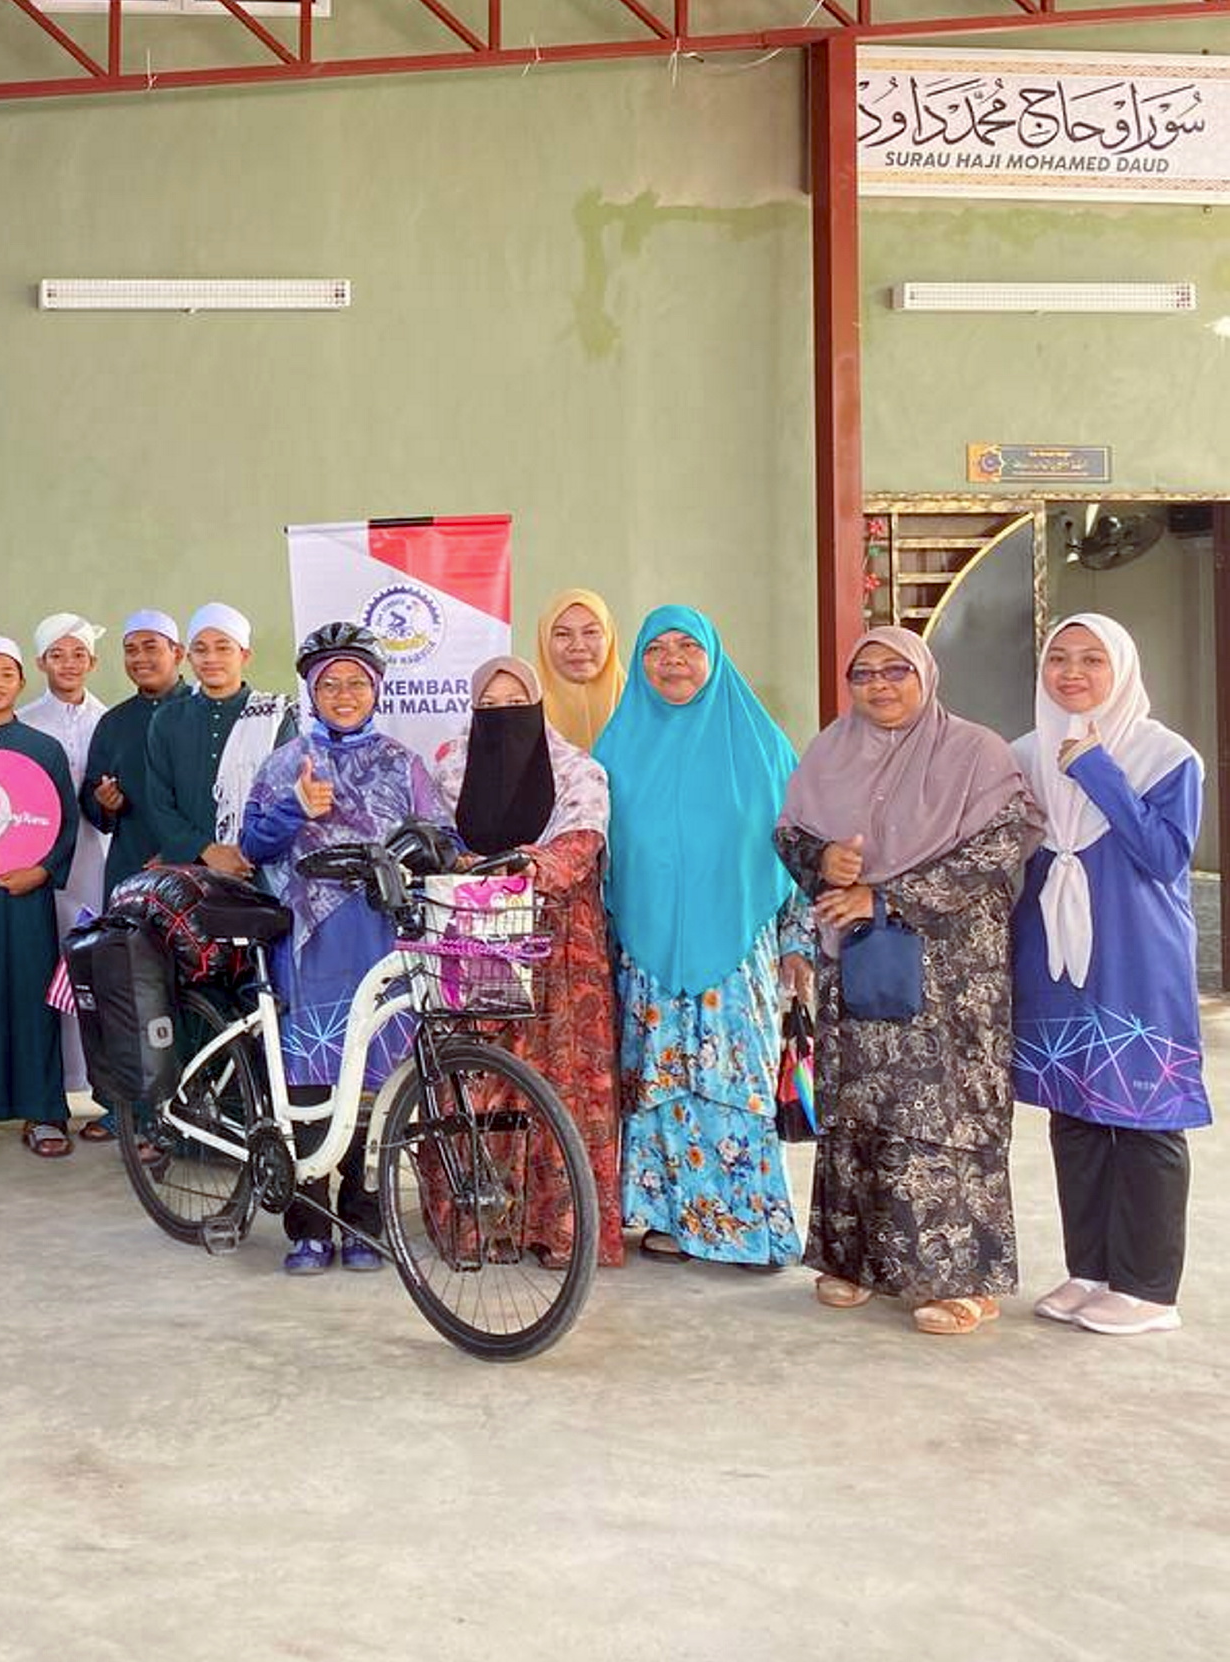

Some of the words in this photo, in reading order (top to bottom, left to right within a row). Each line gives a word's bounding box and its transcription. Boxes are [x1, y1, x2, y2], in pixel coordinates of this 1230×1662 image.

[885, 151, 950, 168] SURAU
[955, 152, 1001, 169] HAJI
[1006, 154, 1110, 172] MOHAMED
[1116, 156, 1169, 173] DAUD
[382, 679, 469, 696] KEMBAR
[399, 700, 470, 714] MALAY
